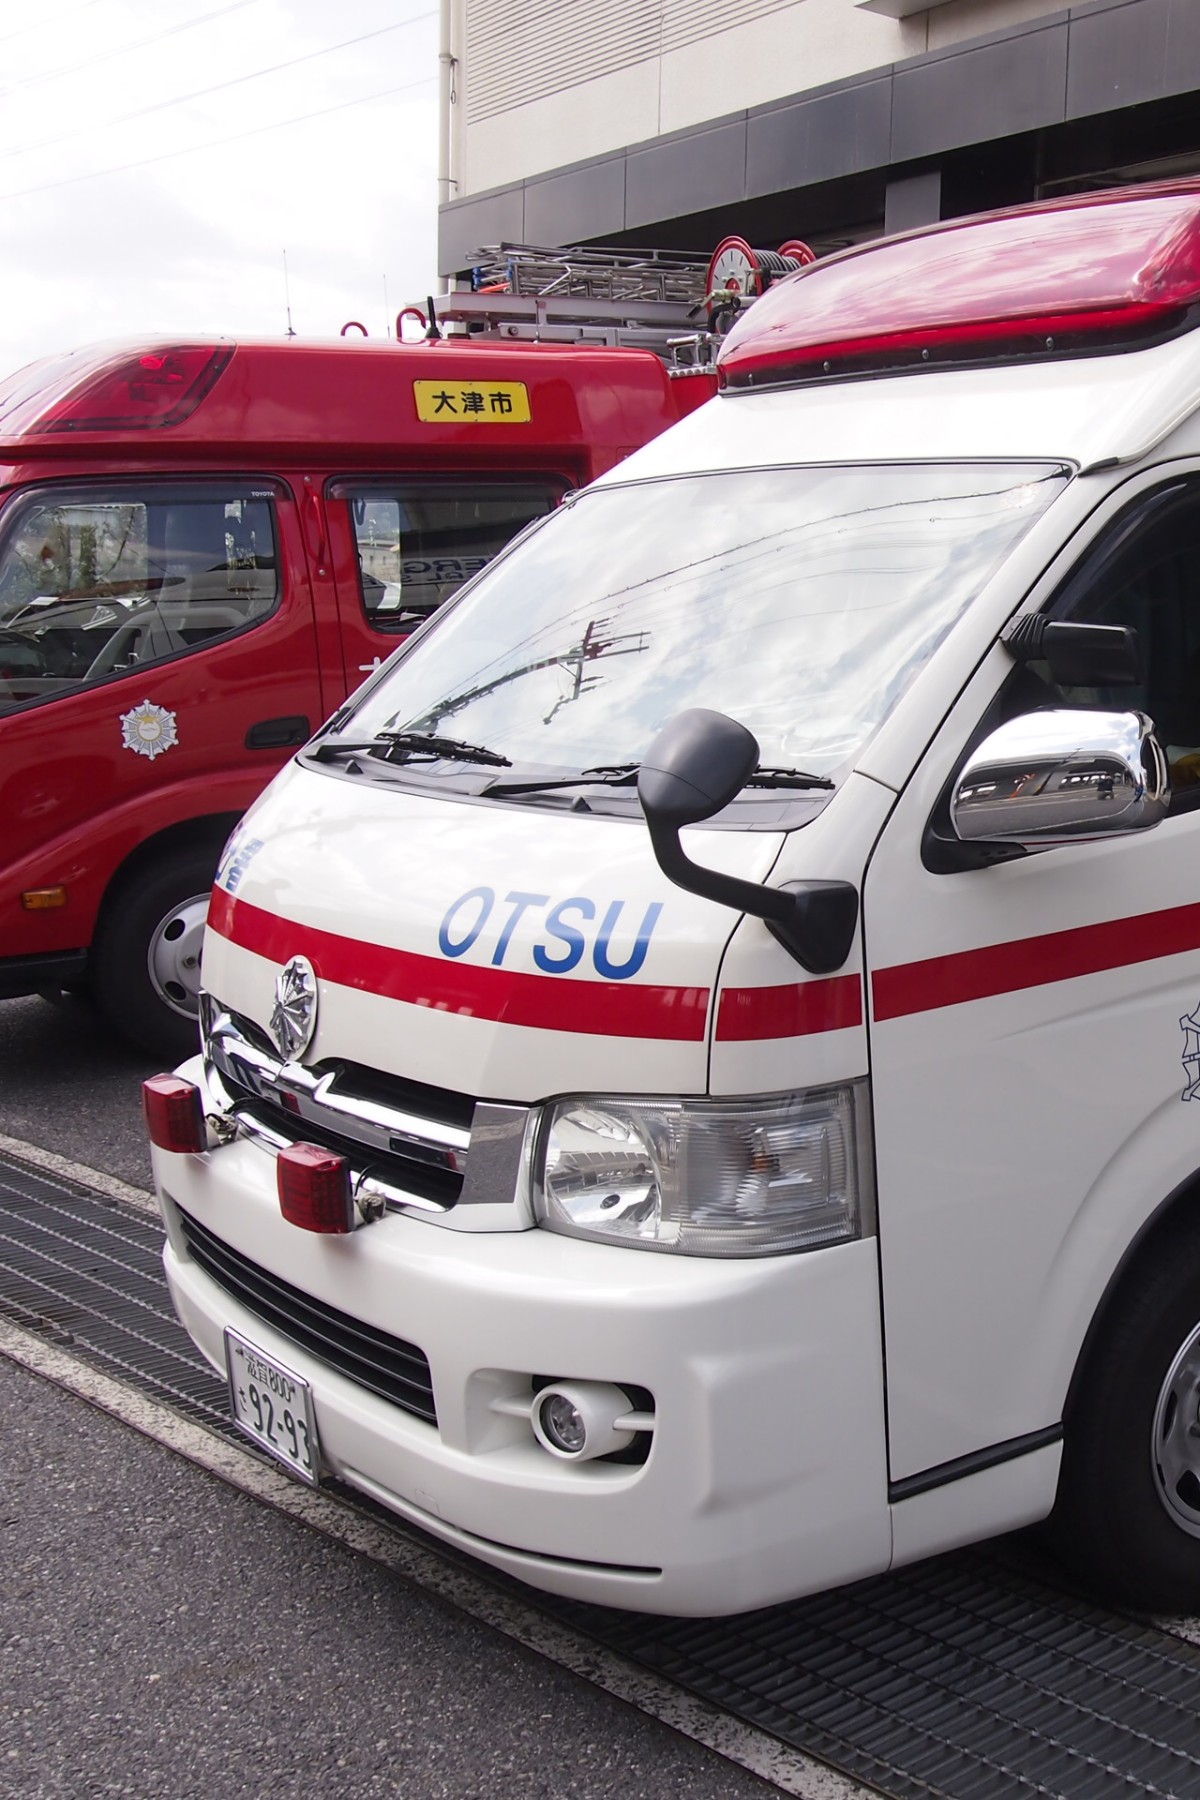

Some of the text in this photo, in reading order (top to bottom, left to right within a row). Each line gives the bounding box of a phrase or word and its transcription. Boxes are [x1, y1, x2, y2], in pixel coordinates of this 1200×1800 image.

[431, 390, 513, 415] 大津市
[438, 886, 664, 980] OTSU
[249, 1383, 313, 1470] 92-93
